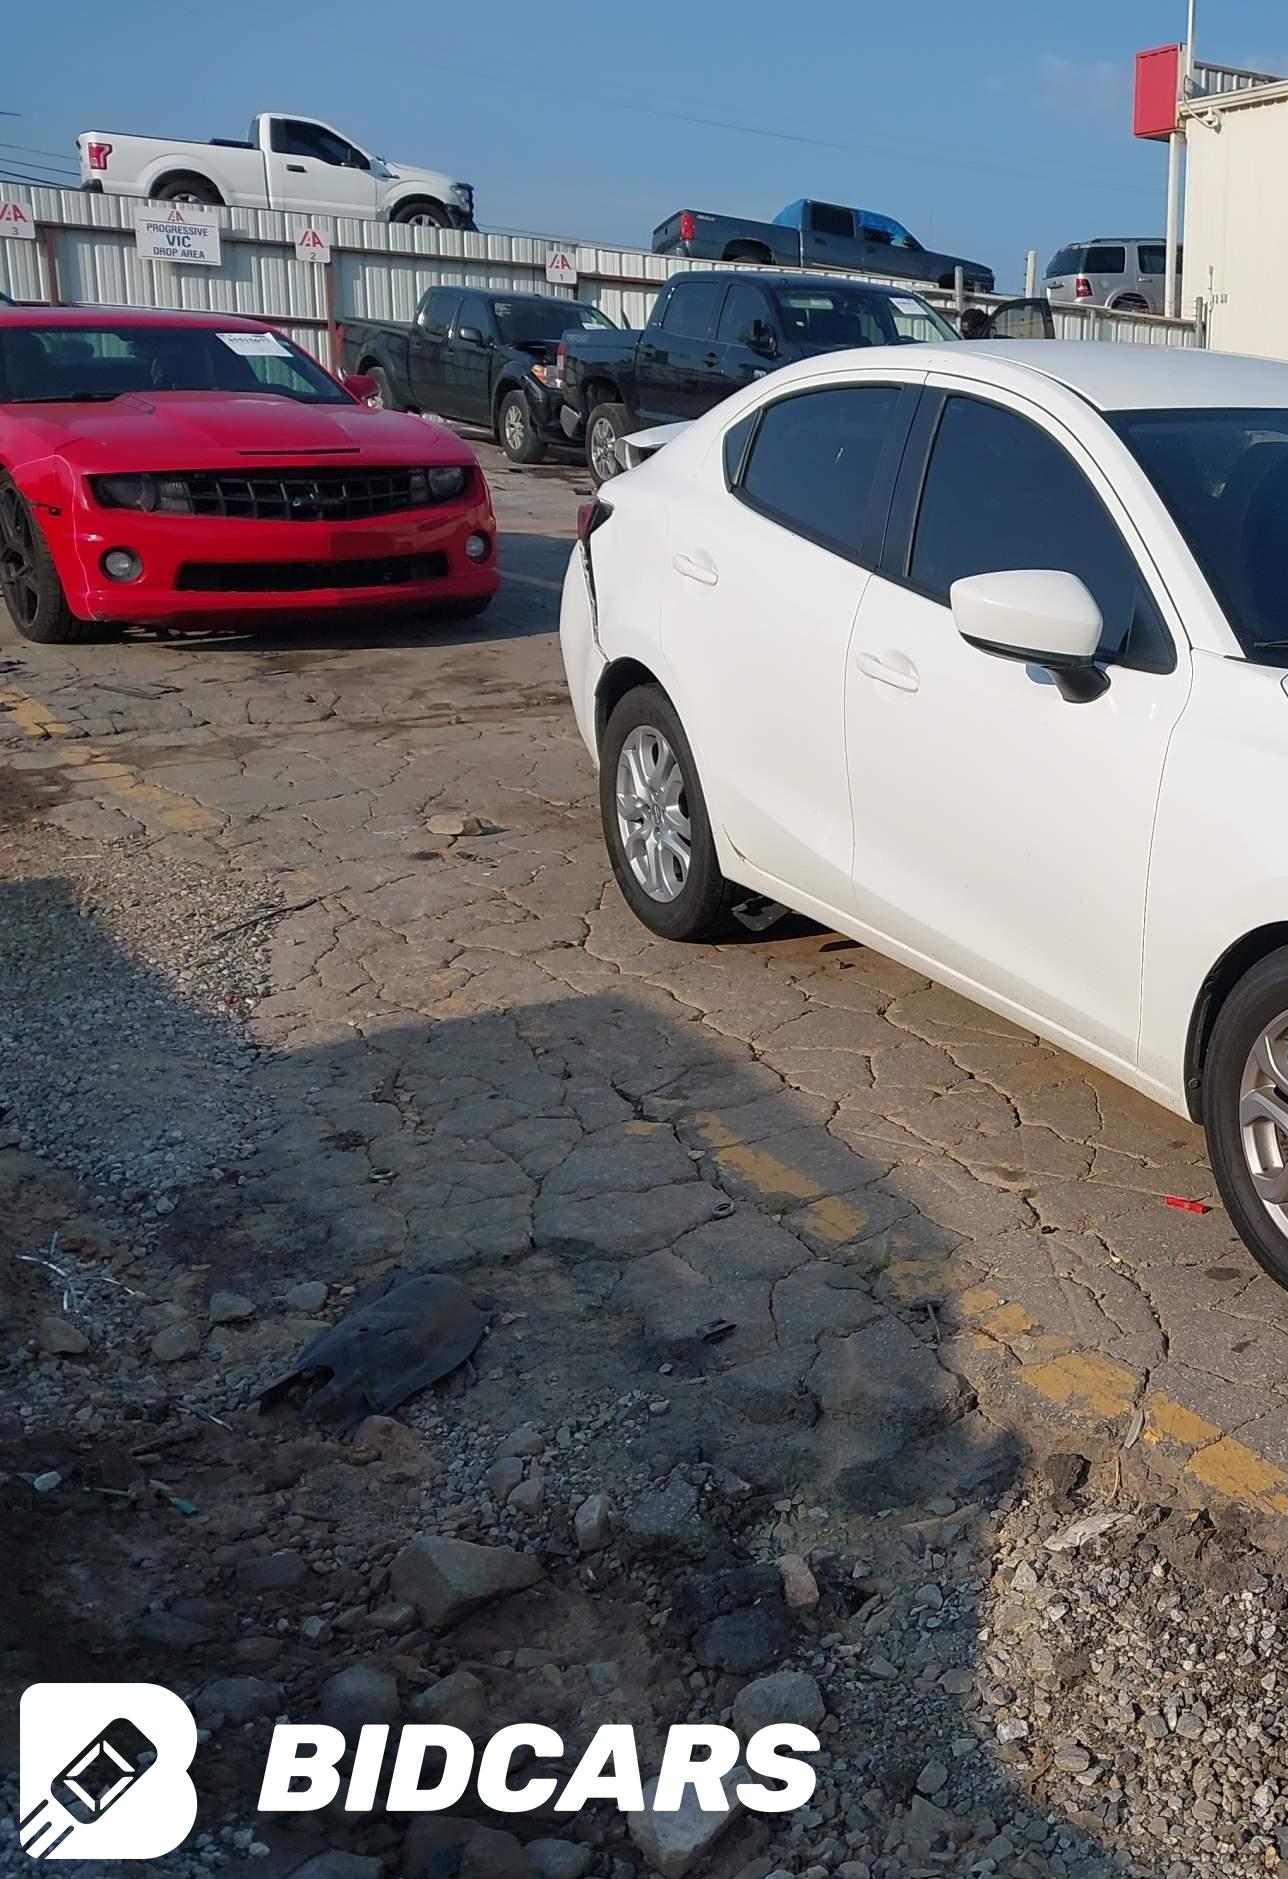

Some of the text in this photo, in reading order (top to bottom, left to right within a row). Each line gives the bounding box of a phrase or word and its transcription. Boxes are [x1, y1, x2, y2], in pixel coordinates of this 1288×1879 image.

[11, 226, 19, 236] 3
[146, 223, 209, 237] PROGRESSIVE
[166, 234, 192, 248] VIC
[153, 246, 205, 259] DROP AREA
[309, 251, 317, 261] 2
